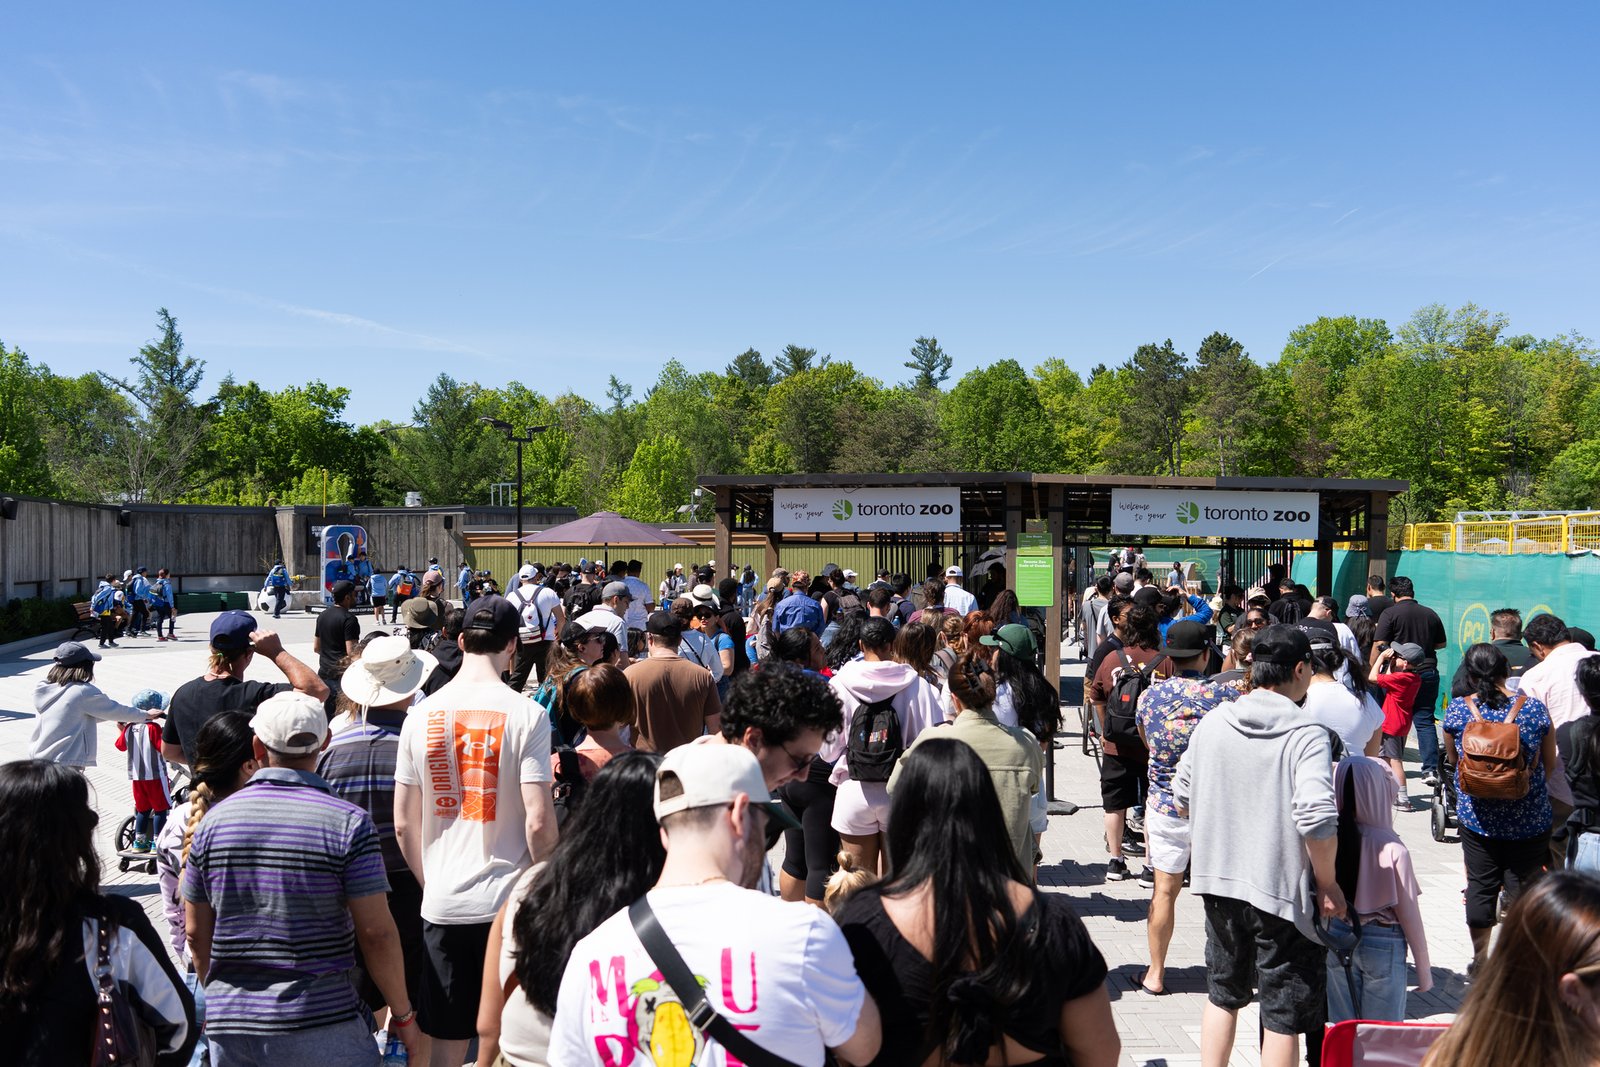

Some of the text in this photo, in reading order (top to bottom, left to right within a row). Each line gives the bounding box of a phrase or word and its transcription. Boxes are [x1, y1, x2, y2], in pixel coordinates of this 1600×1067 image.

[780, 501, 809, 510] Welcome
[857, 502, 954, 516] toronto zoo
[1118, 501, 1151, 511] Welcome
[795, 511, 824, 520] to your
[1134, 513, 1167, 523] to your
[1204, 506, 1311, 523] toronto zoo
[427, 710, 452, 791] ORIGINATORS
